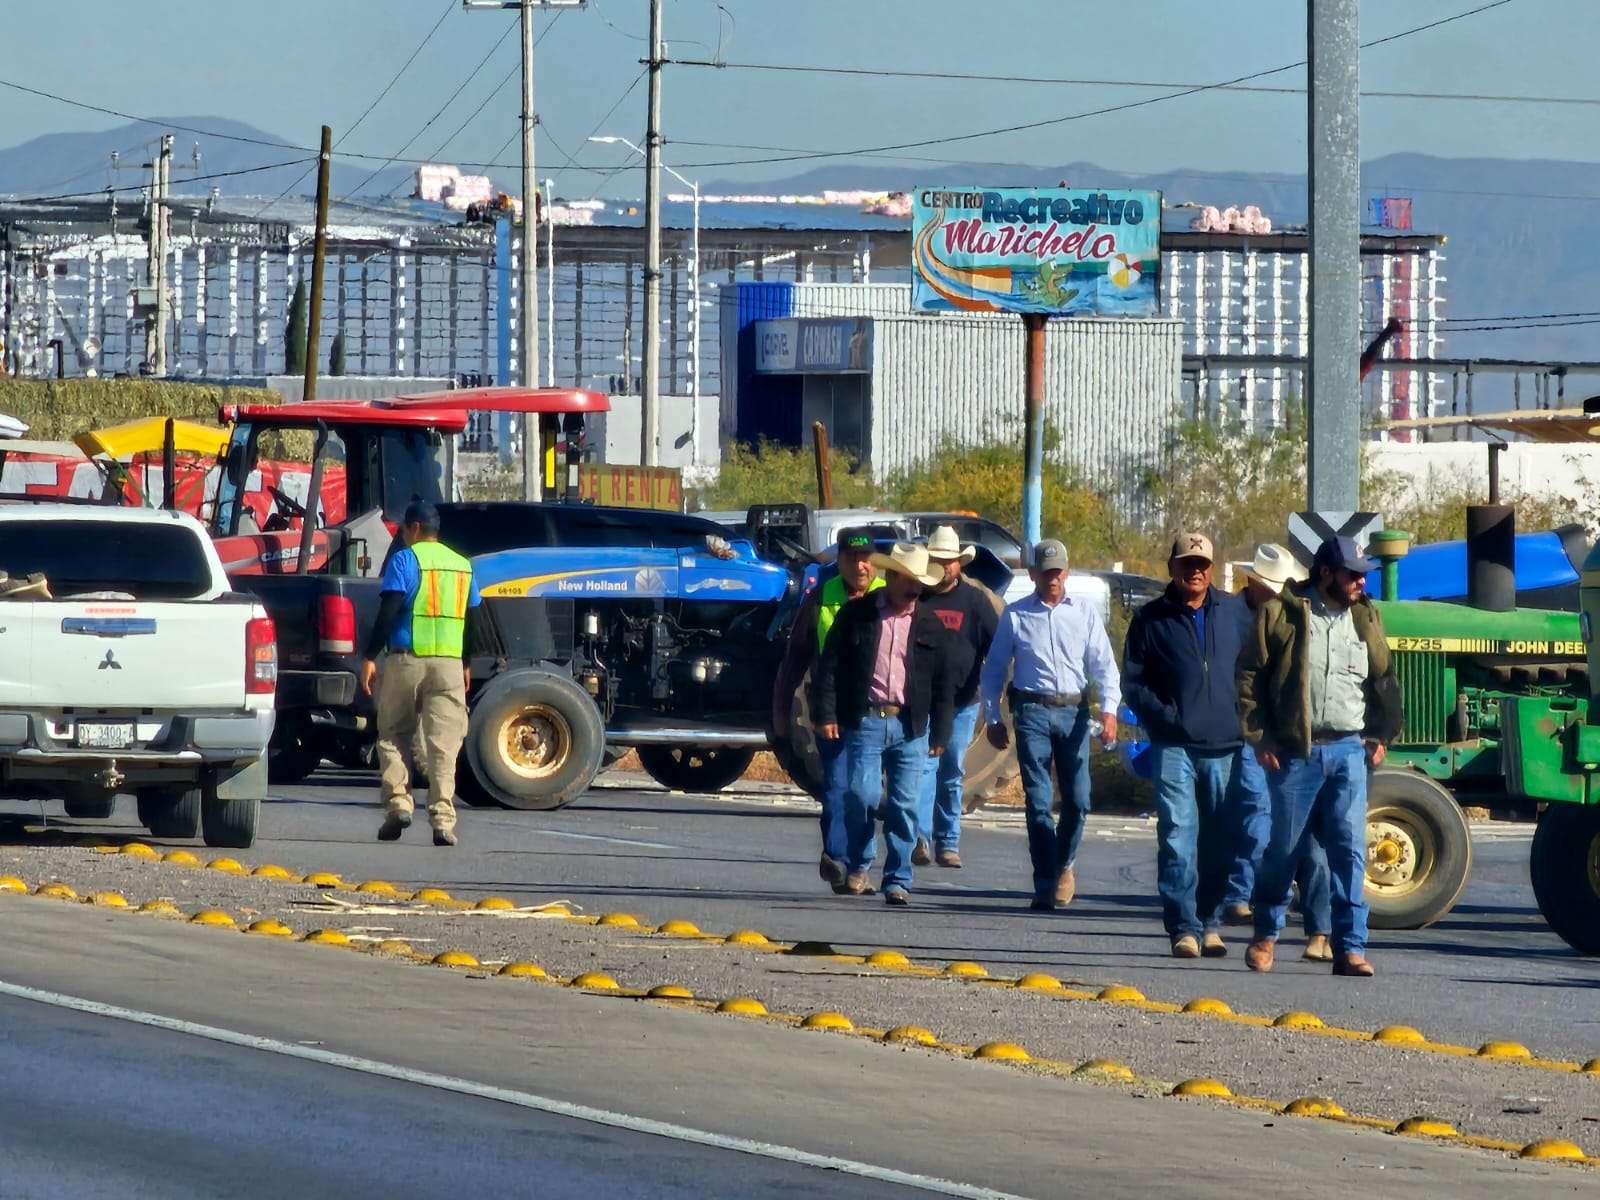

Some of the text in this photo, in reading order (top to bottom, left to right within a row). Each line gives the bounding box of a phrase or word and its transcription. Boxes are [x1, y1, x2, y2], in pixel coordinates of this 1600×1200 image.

[921, 191, 1144, 225] CENTRO Recreativo
[943, 219, 1116, 260] Marichelo
[611, 466, 680, 504] RENTA
[558, 579, 628, 592] New Holland
[1397, 638, 1443, 650] 2735
[1506, 641, 1587, 655] JOHN DEE
